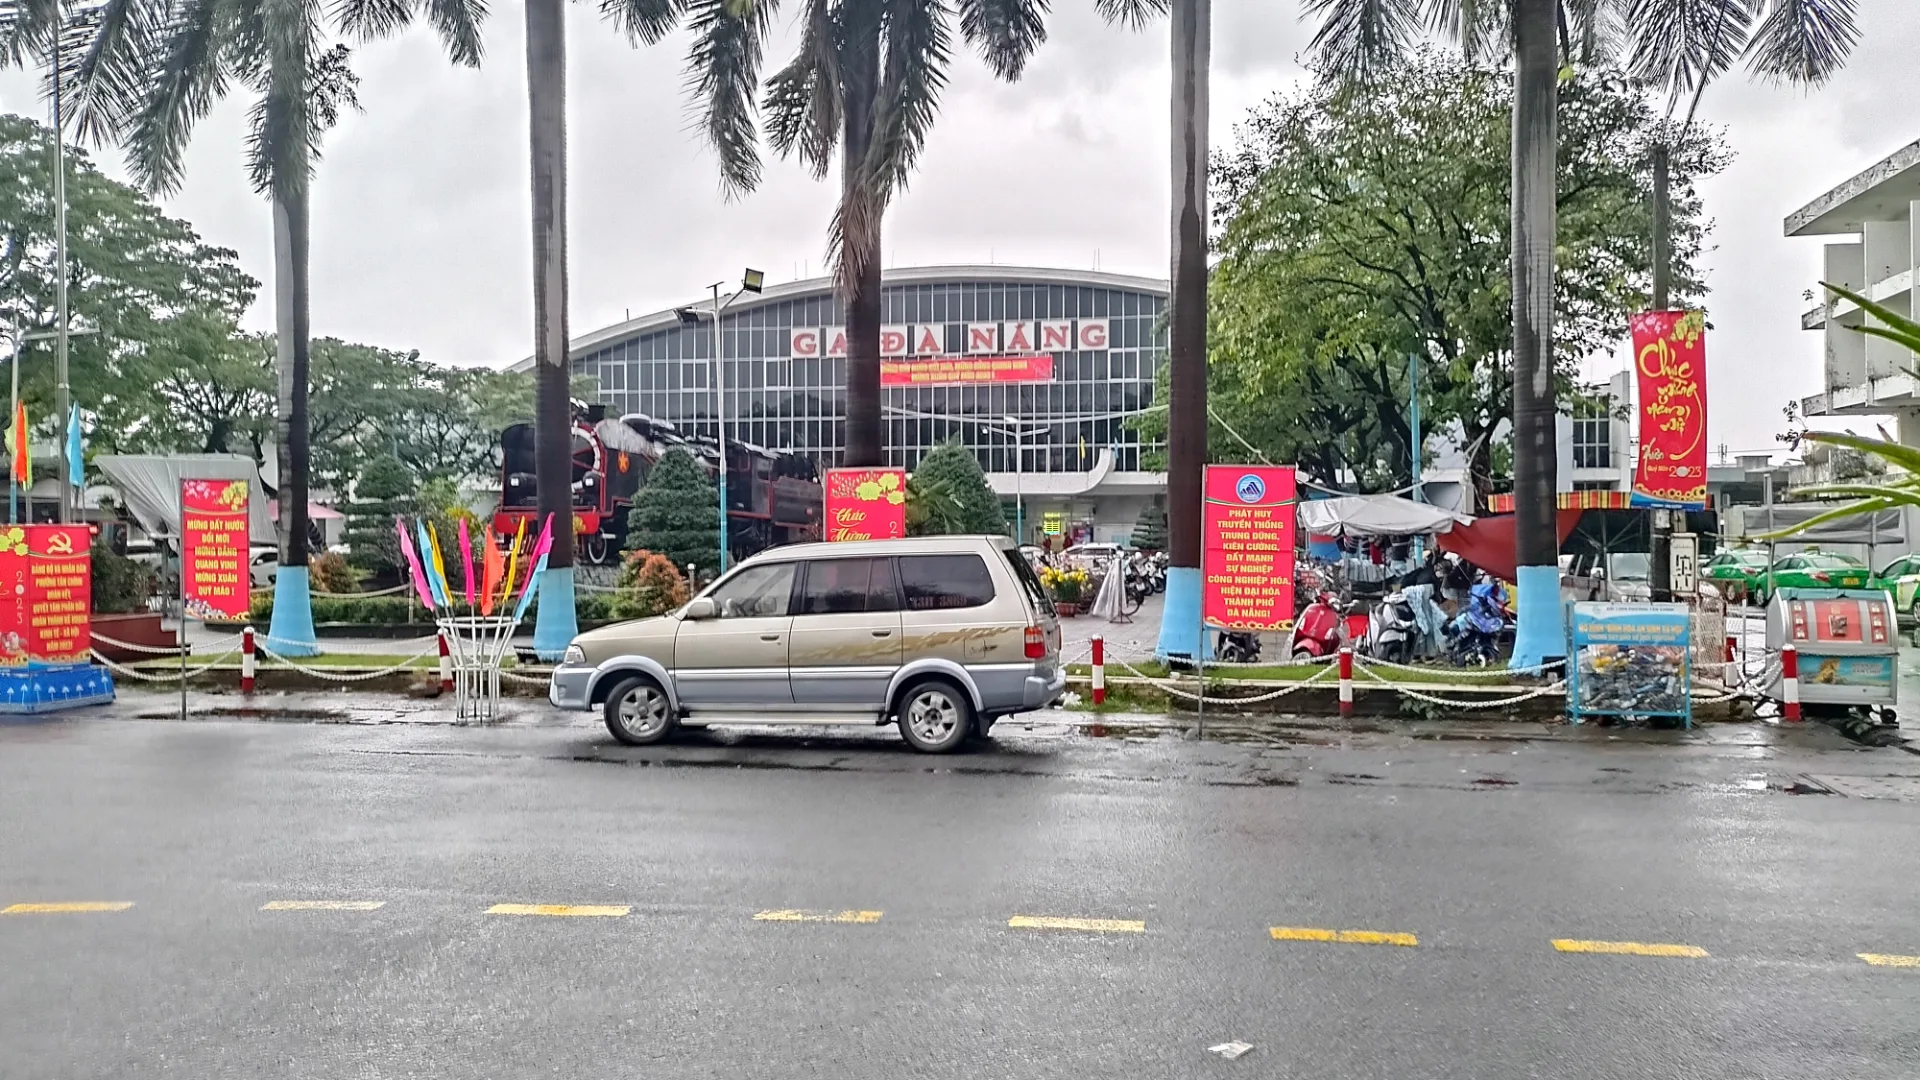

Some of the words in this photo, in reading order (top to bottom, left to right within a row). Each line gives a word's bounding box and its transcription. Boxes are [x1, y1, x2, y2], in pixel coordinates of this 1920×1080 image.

[794, 332, 847, 353] GA
[881, 328, 941, 352] ĐÀ
[830, 507, 867, 528] Chúc
[1229, 508, 1252, 518] PHÁT
[1254, 510, 1272, 518] HUY
[187, 518, 208, 530] MỪNG
[1254, 519, 1284, 529] THỐNG
[1220, 532, 1250, 540] TRUNG
[1223, 541, 1244, 551] KIÊN
[195, 559, 219, 570] QUANG
[220, 560, 238, 570] VINH
[1246, 554, 1274, 564] MẠNH
[1226, 564, 1239, 574] SỰ
[1240, 565, 1274, 575] NGHIỆP
[1208, 574, 1232, 584] CÔNG
[1235, 575, 1268, 585] NGHIỆP
[1220, 586, 1242, 596] HIỆN
[1244, 587, 1260, 597] ĐẠI
[1224, 596, 1254, 606] THÀNH
[1255, 597, 1275, 607] PHỐ
[1227, 608, 1239, 617] ĐÀ
